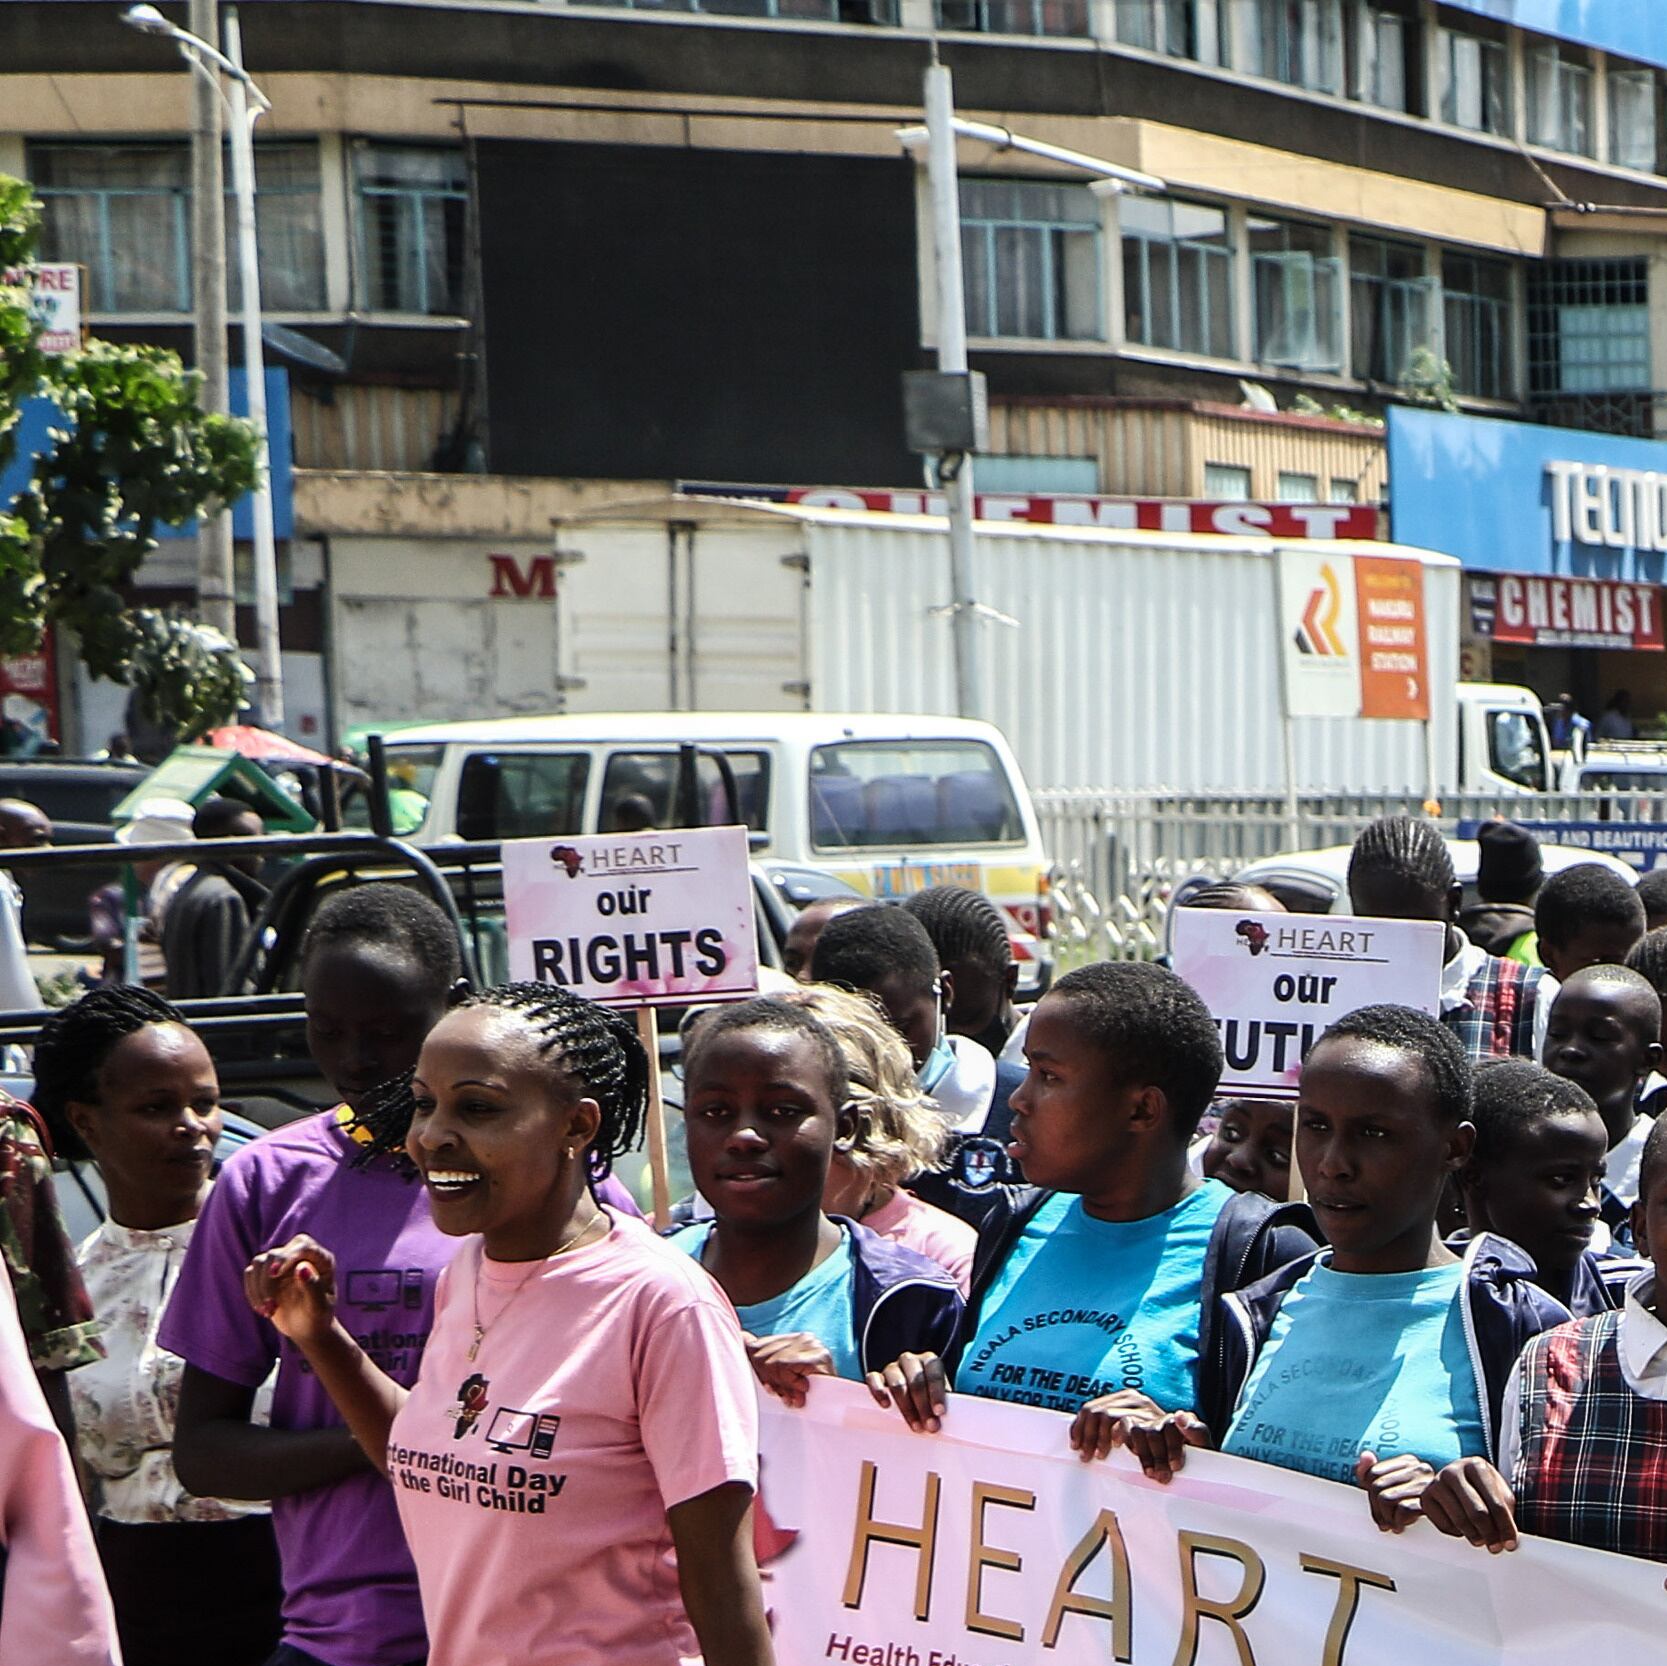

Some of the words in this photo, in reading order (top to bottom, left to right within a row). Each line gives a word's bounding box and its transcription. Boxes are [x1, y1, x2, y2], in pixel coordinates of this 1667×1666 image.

[1501, 576, 1654, 636] CHEMIST
[591, 845, 683, 868] HEART
[596, 887, 651, 917] our
[1277, 928, 1375, 953] HEART
[532, 929, 727, 986] RIGHTS
[1273, 973, 1337, 1004] our
[991, 1363, 1025, 1386] FOR
[1029, 1368, 1065, 1391] THE
[437, 1475, 470, 1504] Girl
[476, 1486, 546, 1514] Child
[507, 1465, 567, 1497] Day
